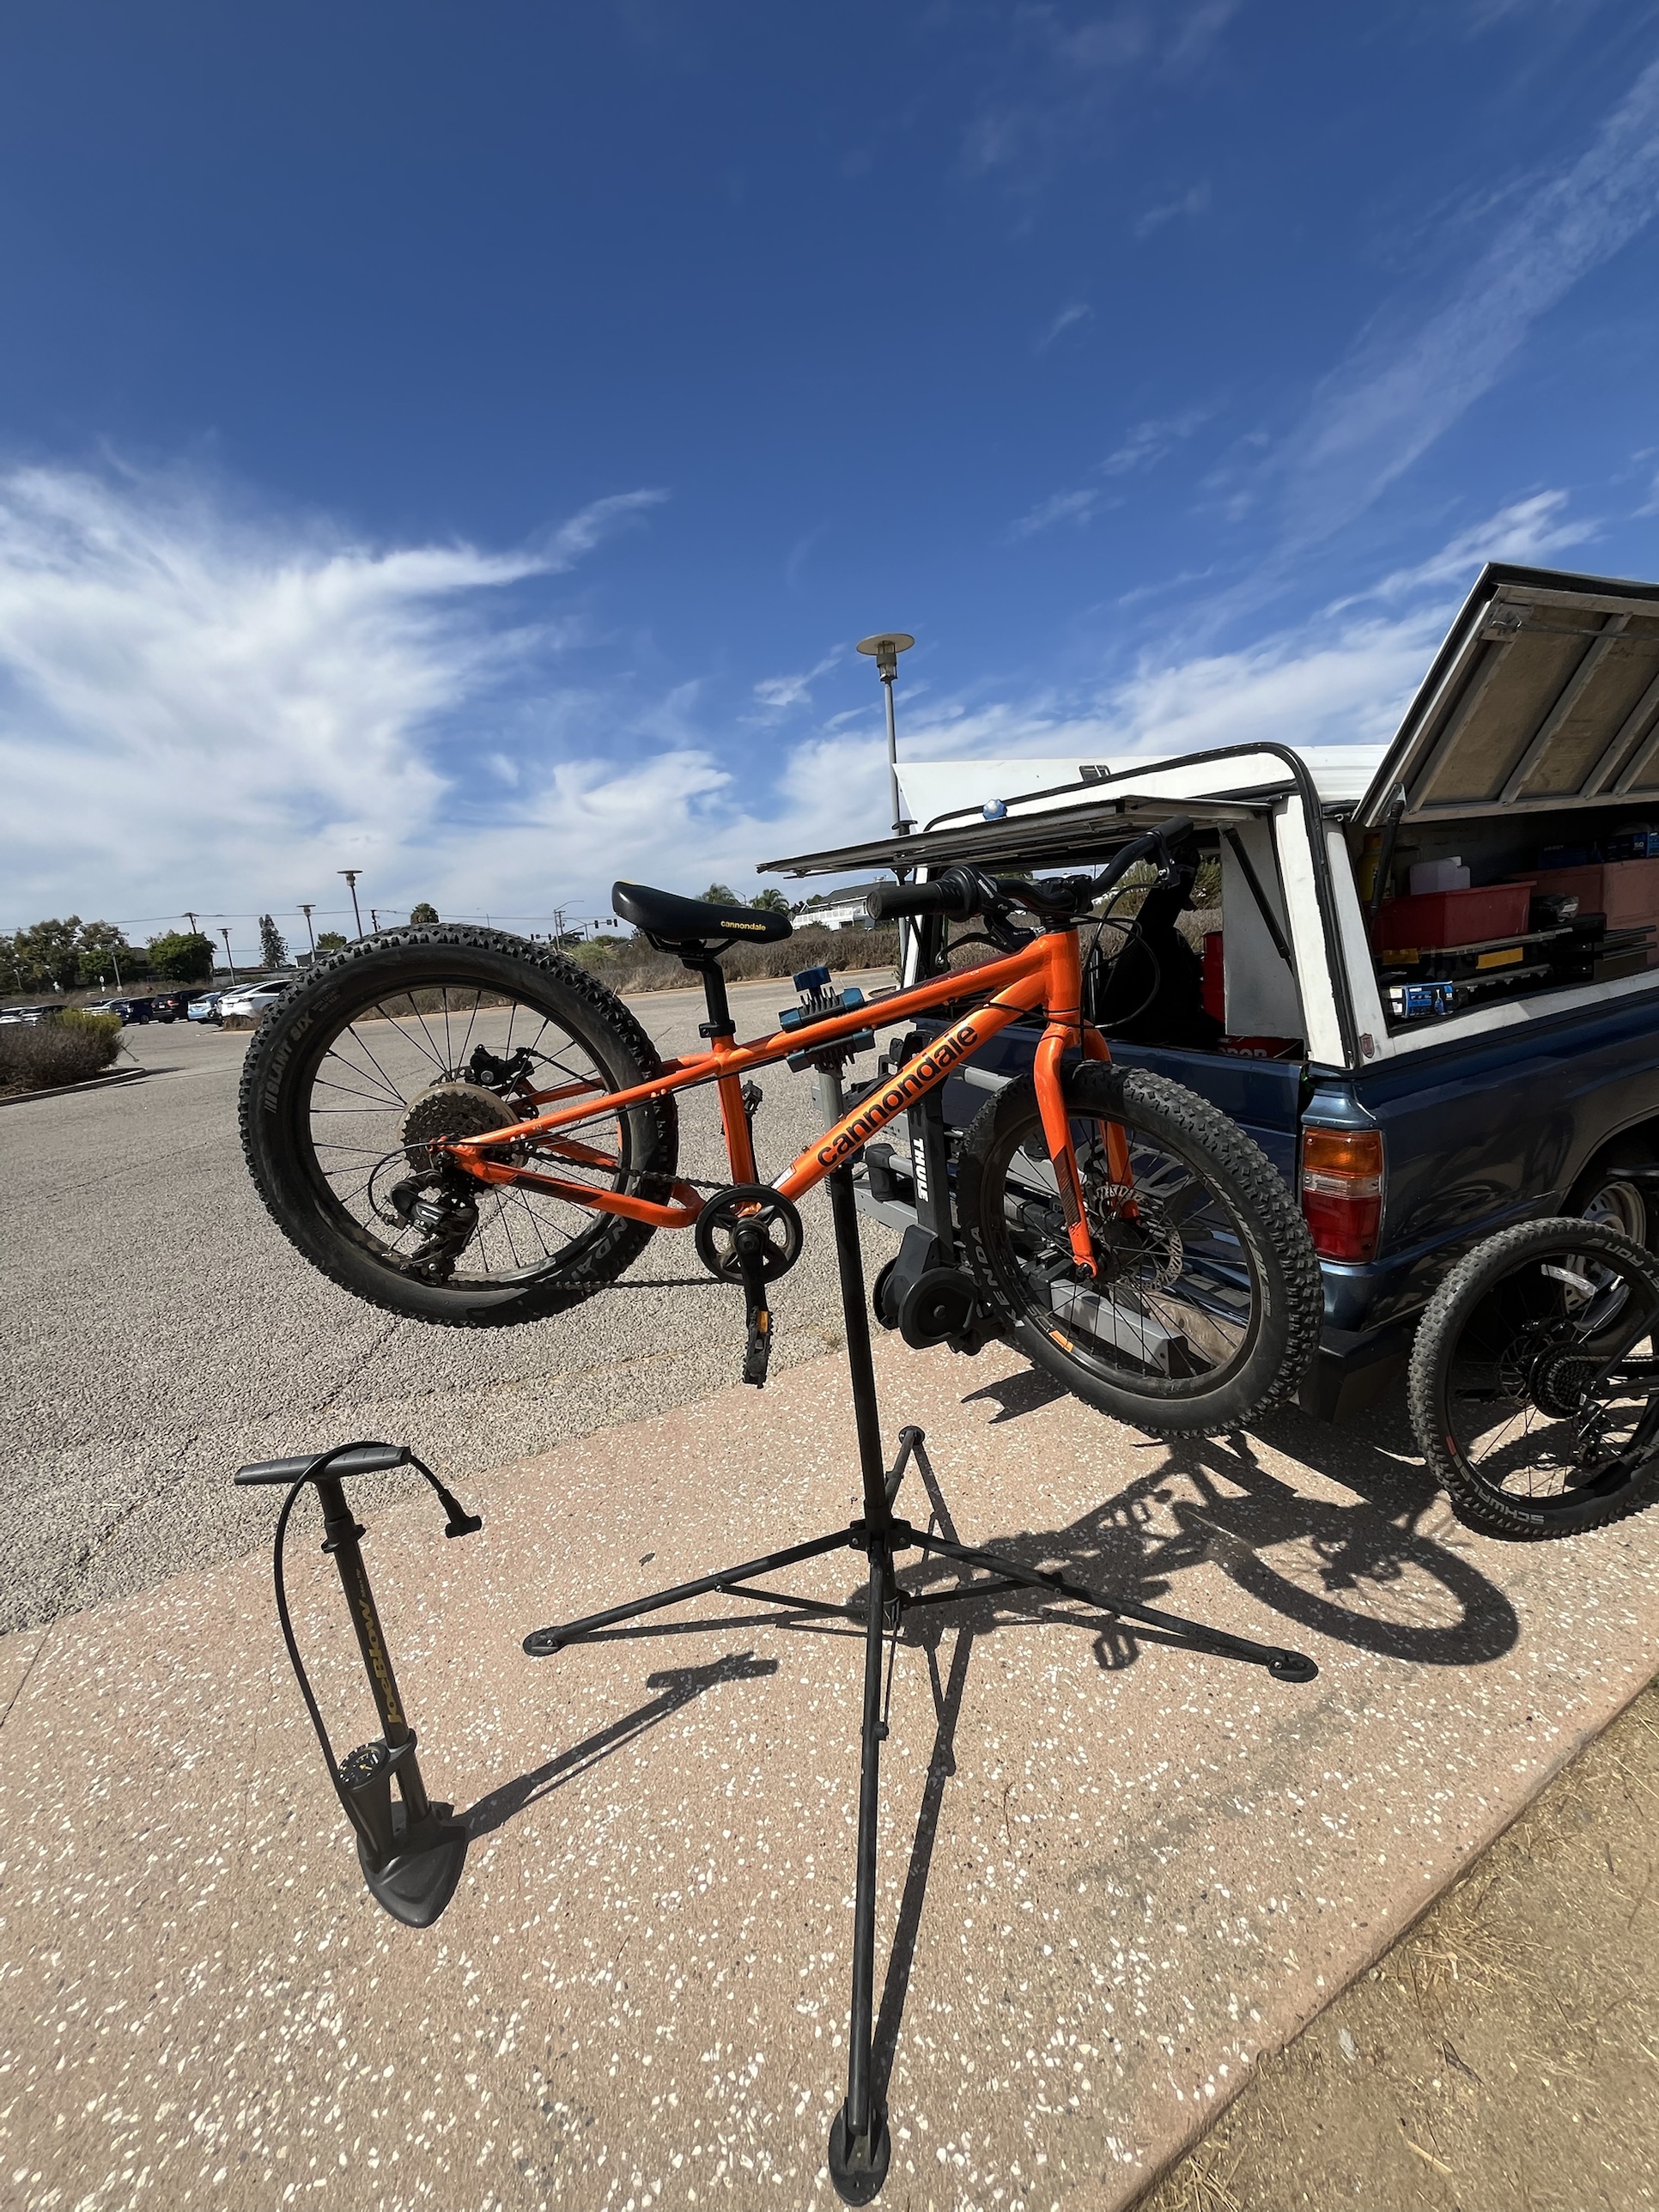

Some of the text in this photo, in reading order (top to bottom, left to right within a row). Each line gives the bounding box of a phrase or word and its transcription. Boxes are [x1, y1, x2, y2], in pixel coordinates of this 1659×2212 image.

[720, 920, 767, 932] cannondale
[267, 1010, 314, 1095] SLANT SIX
[817, 1024, 979, 1168] cannondale
[913, 1137, 929, 1203] THULE
[970, 1226, 1026, 1328] KENDA
[1453, 1453, 1545, 1525] SCHWALBE
[359, 1599, 404, 1724] JoeBlow
